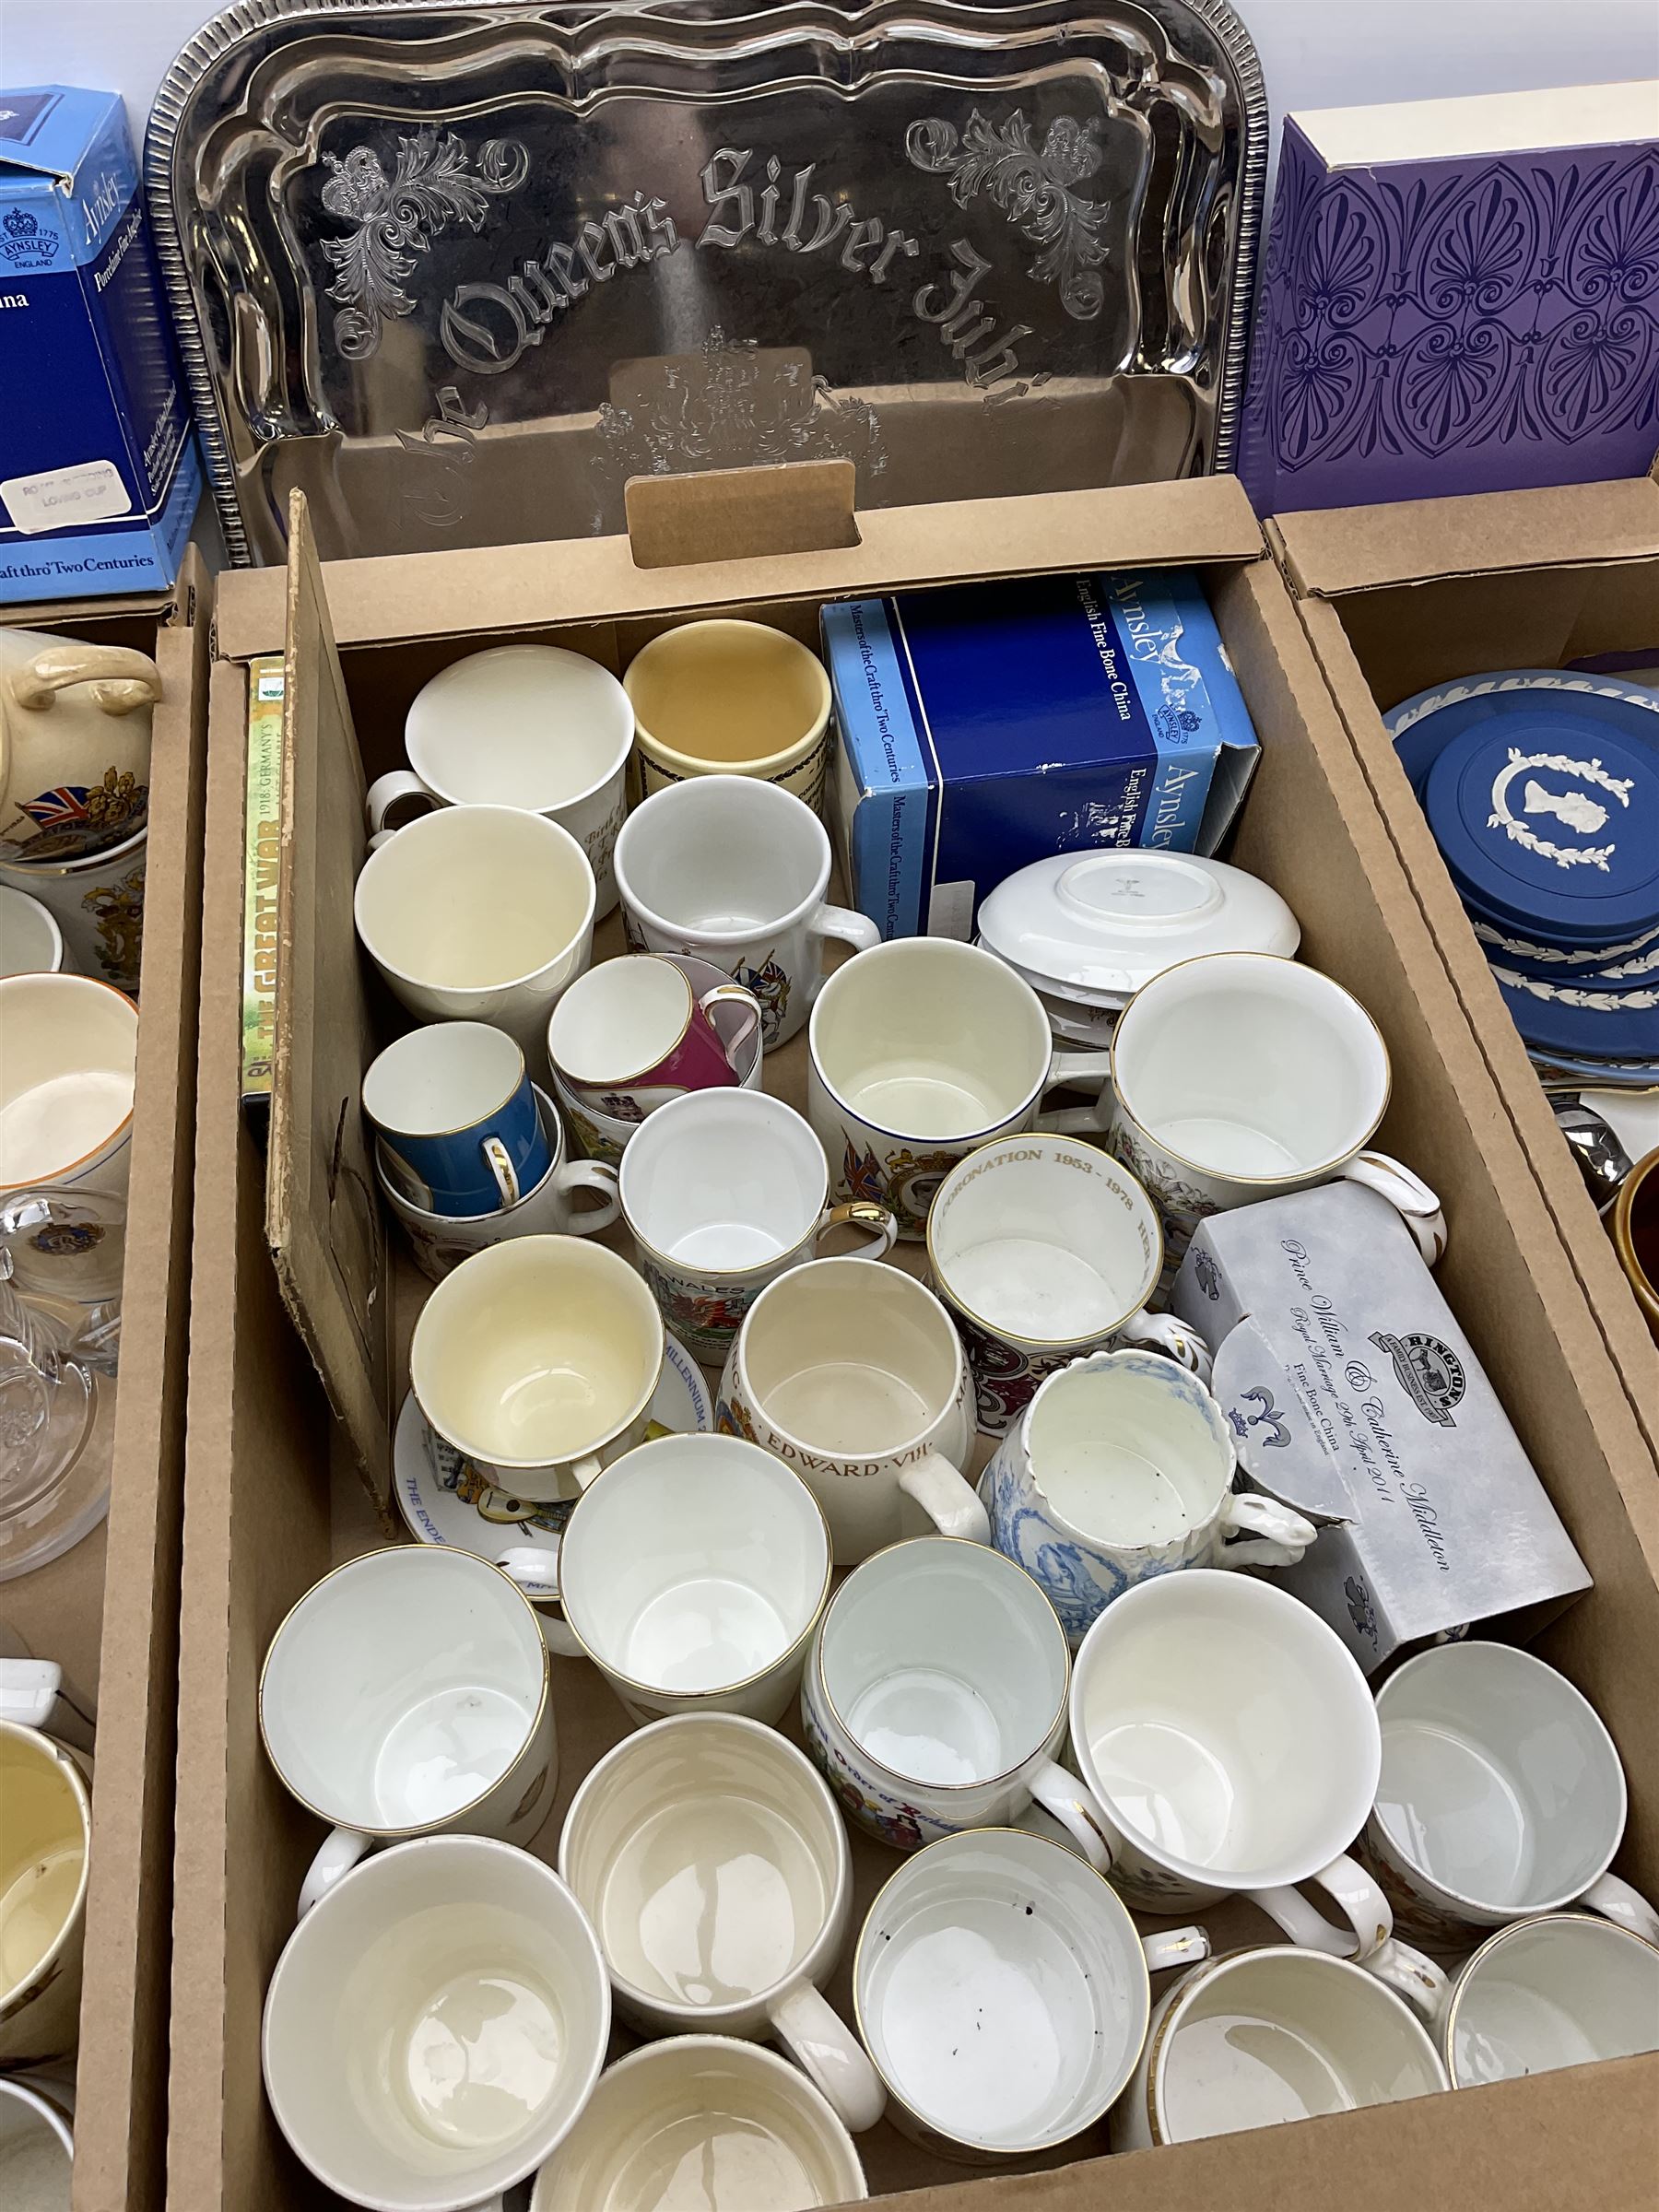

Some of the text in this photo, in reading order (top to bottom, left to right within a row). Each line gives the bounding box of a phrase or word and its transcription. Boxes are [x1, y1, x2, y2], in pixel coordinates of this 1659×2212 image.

[83, 172, 121, 245] Aynsley
[696, 147, 920, 285] Silver
[5, 240, 52, 256] AYNSLEY
[39, 229, 59, 241] 1775
[15, 259, 53, 269] ENGLAND
[94, 247, 121, 293] Porcelaine
[50, 561, 83, 575] Two
[83, 555, 155, 571] Centuries
[850, 605, 865, 641] Masters
[1109, 576, 1163, 665] Aynsley
[859, 640, 870, 650] of
[861, 647, 874, 667] the
[1077, 579, 1132, 721] English Fine Bone China
[865, 665, 882, 693] Craft
[877, 711, 890, 735] Two
[1152, 713, 1165, 738] ENGLAND
[1162, 709, 1178, 739] AYNSLEY
[259, 724, 273, 815] 1918: GERMANY'S
[881, 733, 902, 783] Centuries
[1124, 768, 1147, 812] English
[1142, 765, 1199, 850] Aynsley
[892, 795, 906, 832] Masters
[256, 818, 279, 891] WAR
[888, 854, 902, 879] Craft
[890, 841, 903, 855] the
[887, 895, 900, 916] Two
[254, 895, 278, 994] GREAT
[886, 914, 899, 939] Centu
[257, 1001, 275, 1040] THE
[1053, 1152, 1094, 1174] 1953
[1105, 1178, 1135, 1211] 1978
[665, 1273, 746, 1294] WALES
[1389, 1340, 1406, 1363] FAMILY
[1402, 1363, 1420, 1394] BUSINESS
[1407, 1336, 1464, 1406] RINGTONS
[1280, 1239, 1450, 1572] Prince William & Catherine Middleton
[1290, 1307, 1317, 1344] Royal
[1308, 1345, 1339, 1399] Marriage
[1335, 1401, 1358, 1427] 29th
[1349, 1430, 1377, 1465] April
[1367, 1466, 1395, 1503] 2011
[1293, 1363, 1339, 1452] Fine Bone China
[767, 1431, 879, 1477] EDWARD
[891, 1447, 929, 1469] VIII
[1313, 1430, 1329, 1456] England
[406, 1477, 423, 1507] THE
[833, 1748, 877, 1792] Order
[878, 1793, 898, 1804] of
